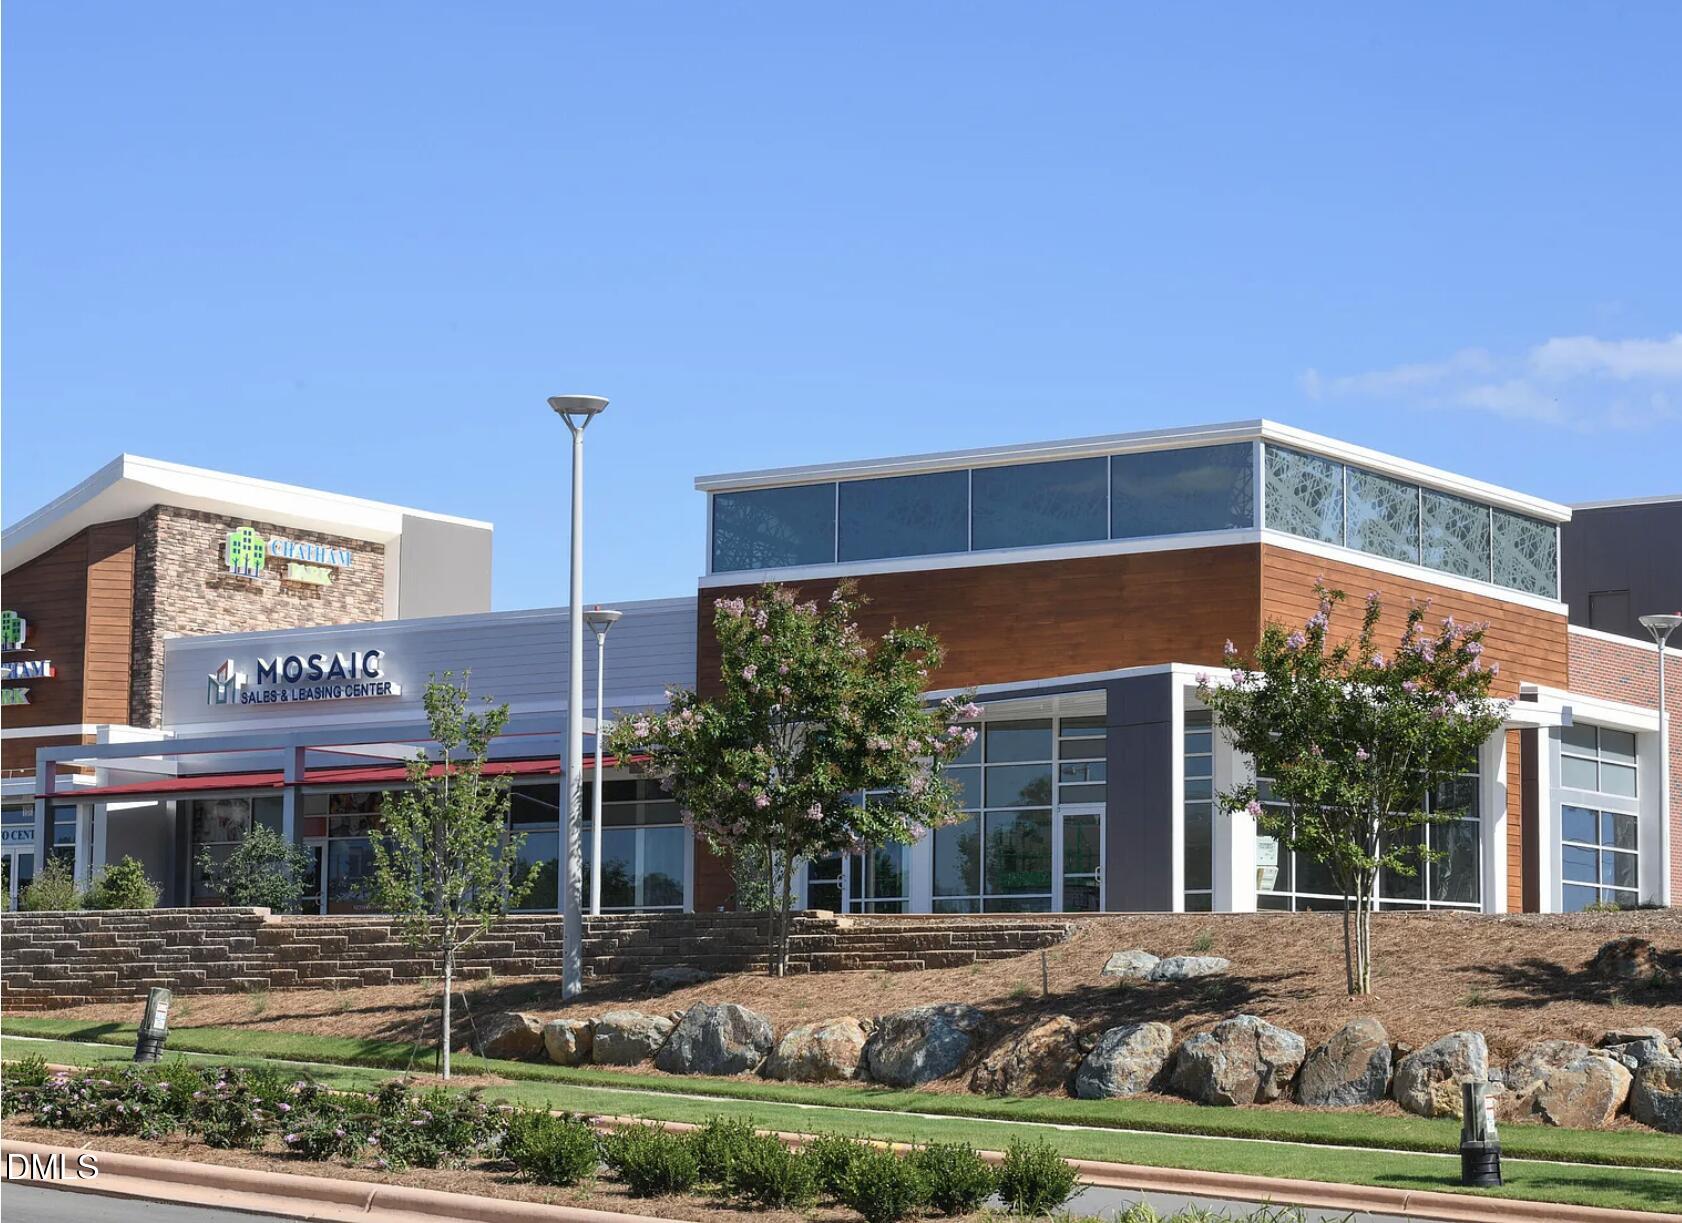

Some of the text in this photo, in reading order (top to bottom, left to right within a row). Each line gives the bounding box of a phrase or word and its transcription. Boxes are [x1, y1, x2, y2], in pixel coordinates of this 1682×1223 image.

[270, 539, 353, 567] CHATHAM
[257, 649, 384, 685] MOSAIC
[240, 681, 392, 705] SALES & LEASING CENTER
